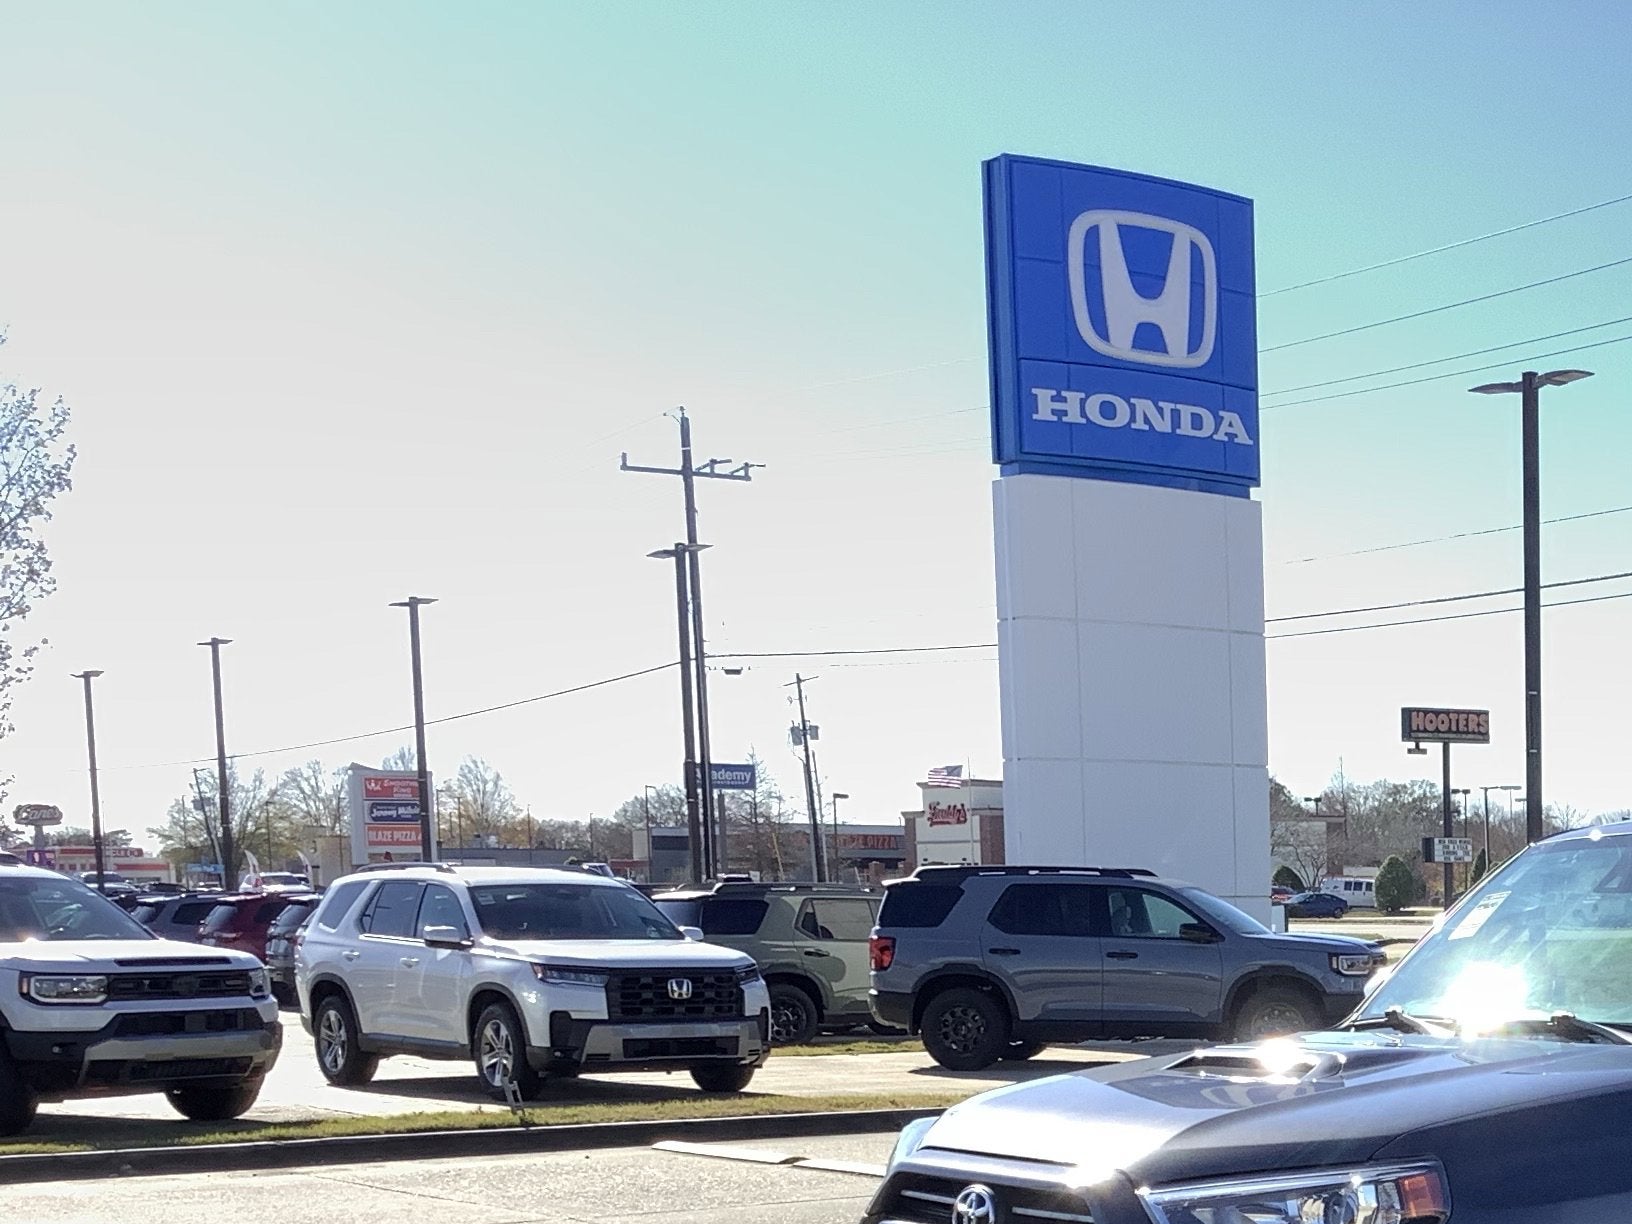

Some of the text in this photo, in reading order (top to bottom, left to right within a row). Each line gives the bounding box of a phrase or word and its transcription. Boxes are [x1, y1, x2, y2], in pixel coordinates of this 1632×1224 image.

[1031, 387, 1253, 445] HONDA
[1411, 711, 1488, 733] HOOTERS
[393, 831, 416, 842] PIZZA
